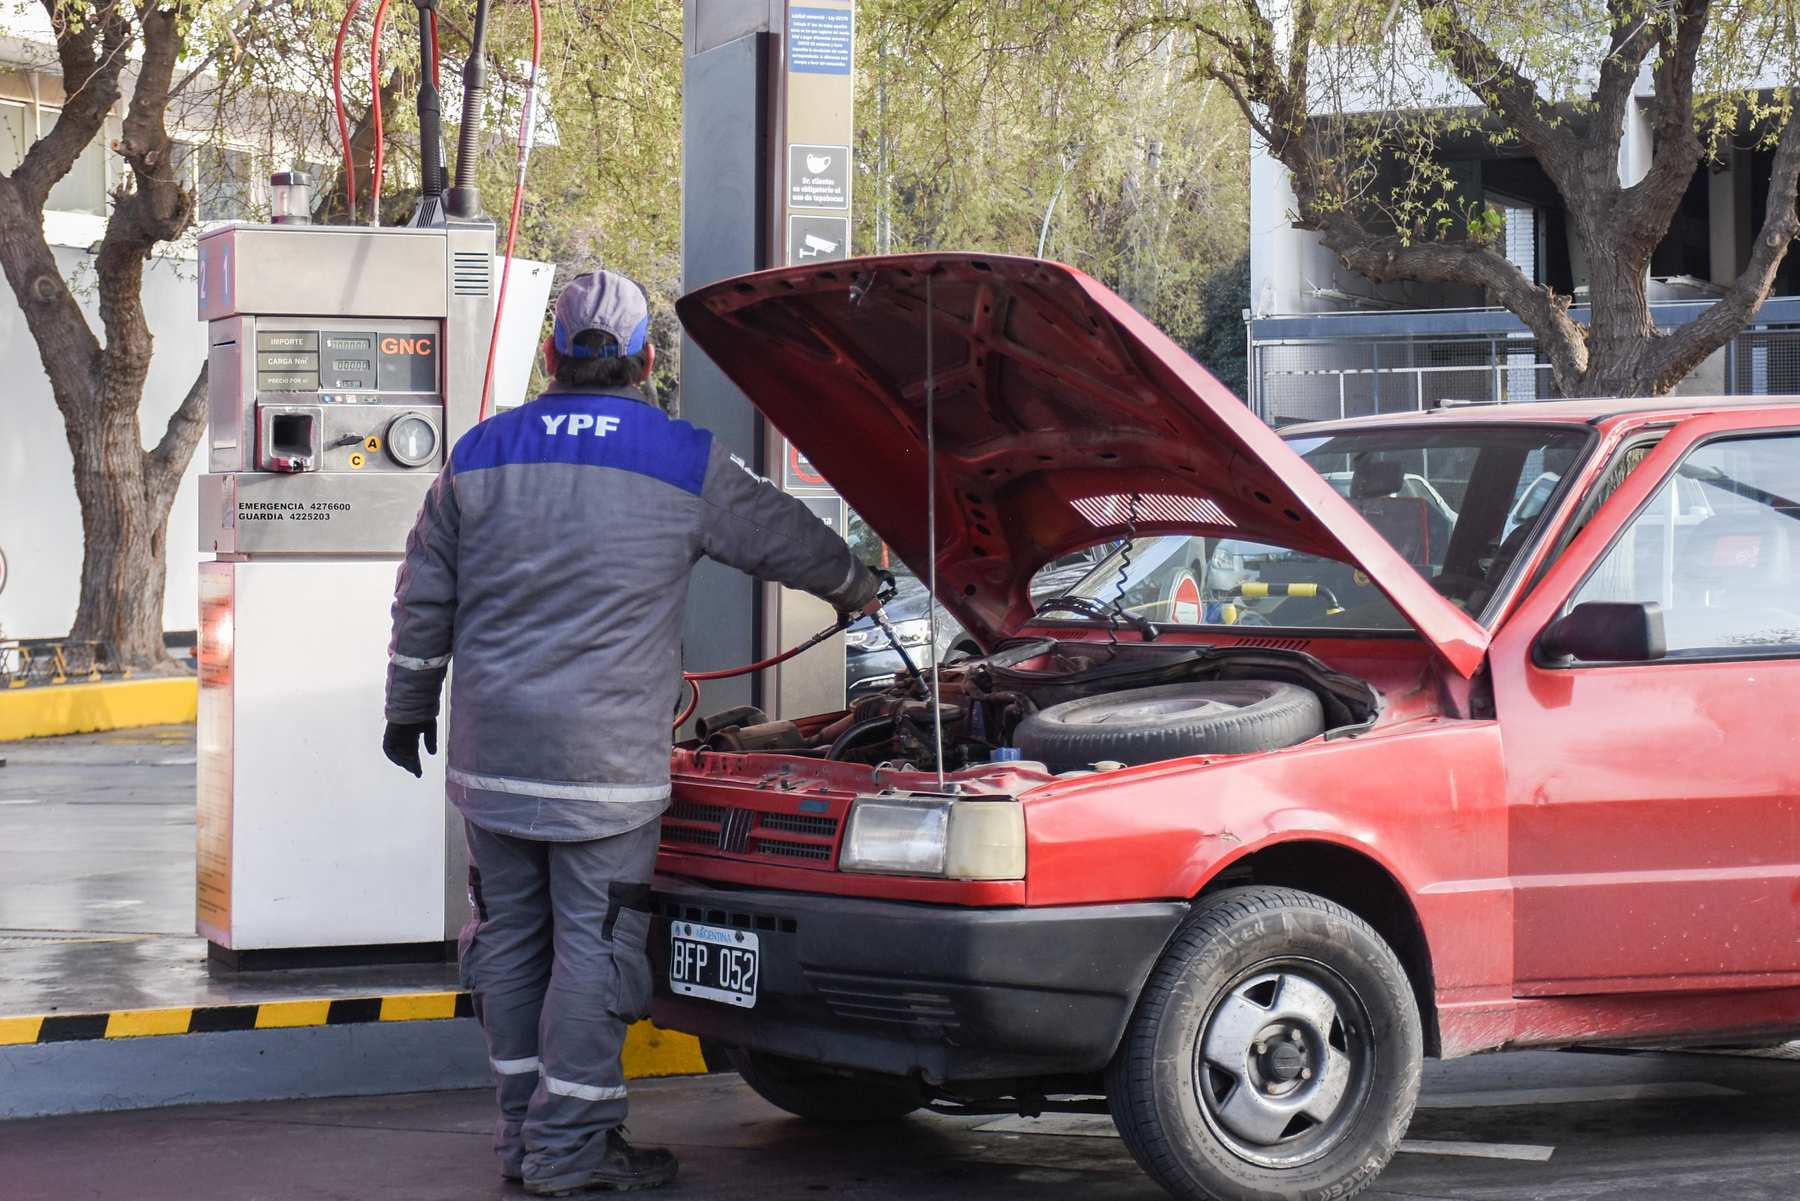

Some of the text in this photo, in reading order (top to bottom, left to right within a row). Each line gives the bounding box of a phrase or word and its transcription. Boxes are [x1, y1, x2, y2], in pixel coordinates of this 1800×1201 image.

[381, 338, 432, 356] GNC
[541, 414, 620, 437] YPF
[367, 438, 377, 449] A
[351, 455, 361, 465] C
[238, 502, 351, 511] EMERGENCIA 4276600
[238, 512, 331, 521] GUARDIA 4225203
[695, 926, 732, 943] ARGENTINA
[673, 940, 754, 993] BFP 052
